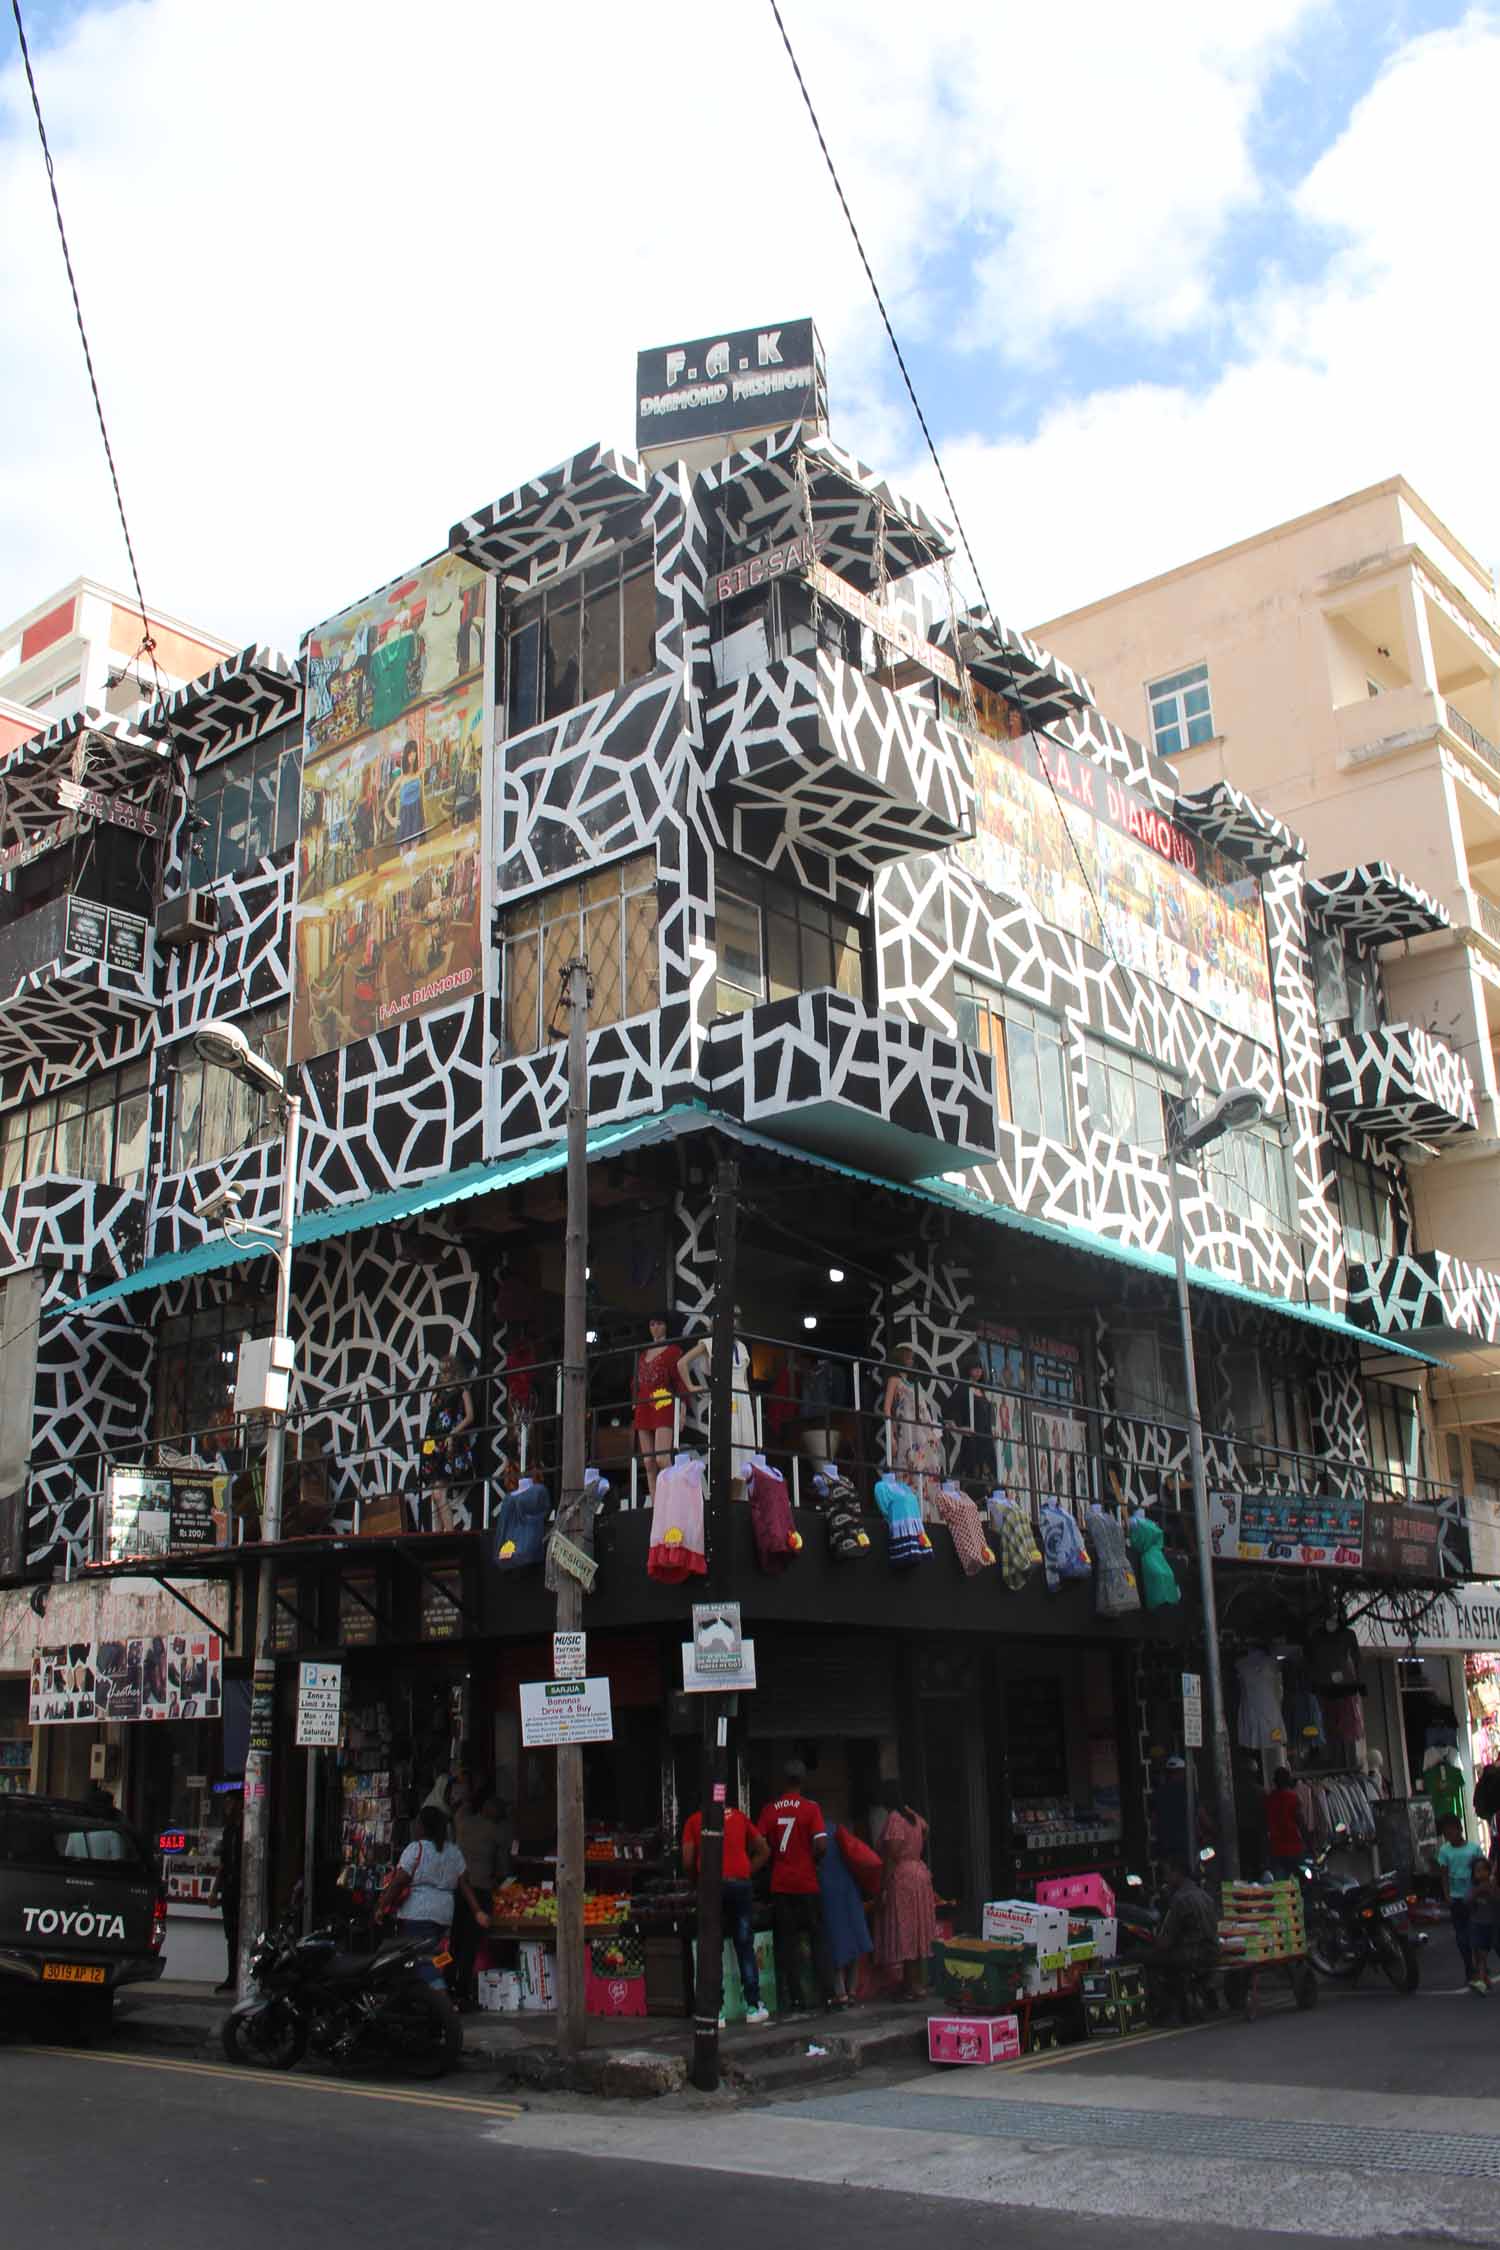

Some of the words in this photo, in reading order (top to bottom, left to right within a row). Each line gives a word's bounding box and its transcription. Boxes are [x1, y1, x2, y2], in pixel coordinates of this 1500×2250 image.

[640, 382, 728, 416] DIAMOND
[732, 367, 813, 402] FASHION
[716, 560, 763, 602] BIG
[1106, 779, 1196, 874] DIAMOND
[379, 993, 411, 1020] F.A.K
[411, 967, 473, 1007] DIAMOND
[555, 1635, 582, 1646] MUSIC
[567, 1705, 573, 1713] &
[576, 1703, 592, 1713] Buy
[303, 1727, 331, 1737] Saturday
[159, 1834, 185, 1849] SALE
[777, 1816, 797, 1853] 7
[23, 1907, 126, 1940] TOYOTA
